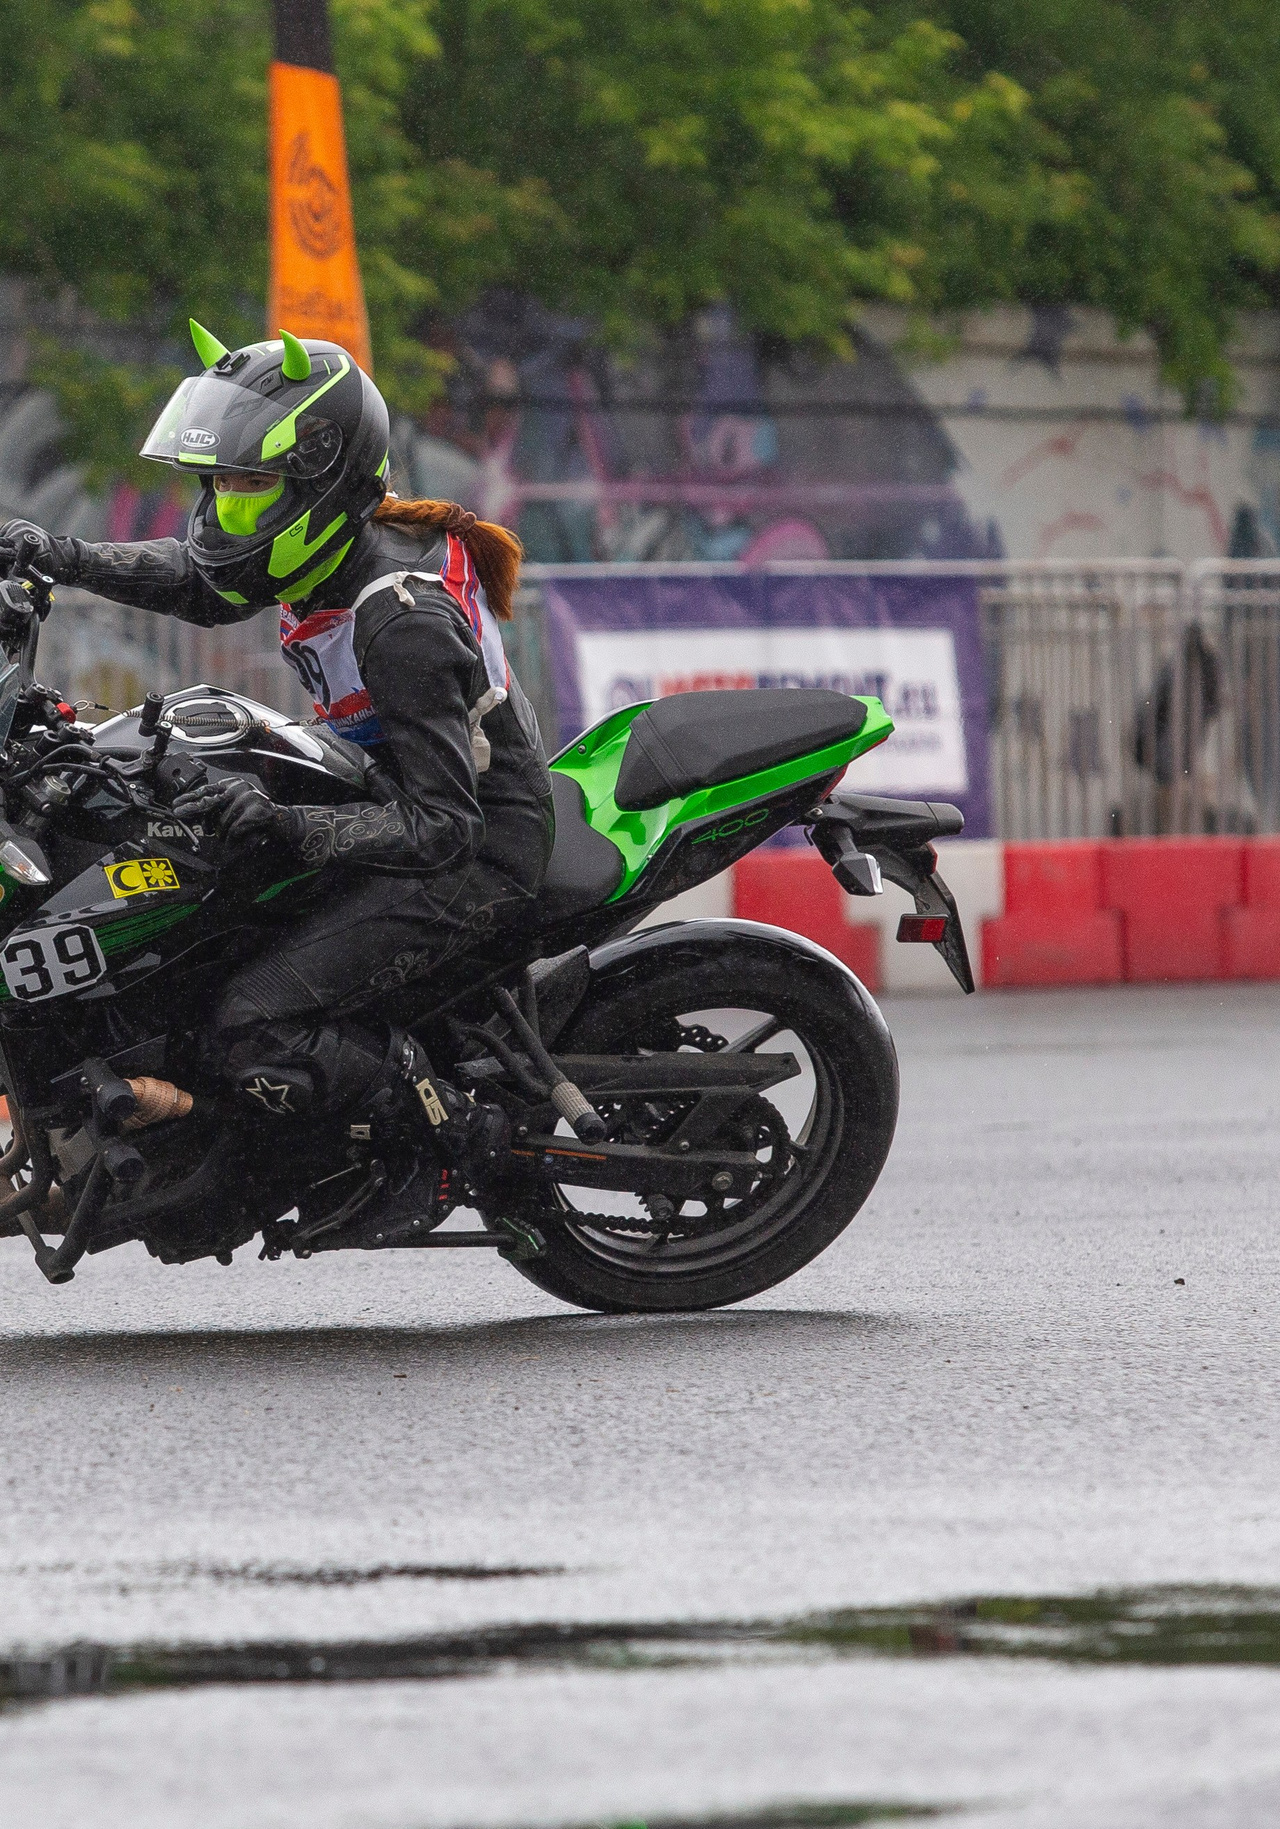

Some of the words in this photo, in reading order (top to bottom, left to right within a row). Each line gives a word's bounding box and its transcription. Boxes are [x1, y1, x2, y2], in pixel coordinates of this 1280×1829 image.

[182, 432, 213, 445] HJC
[691, 808, 769, 845] 400
[3, 925, 104, 1000] 39
